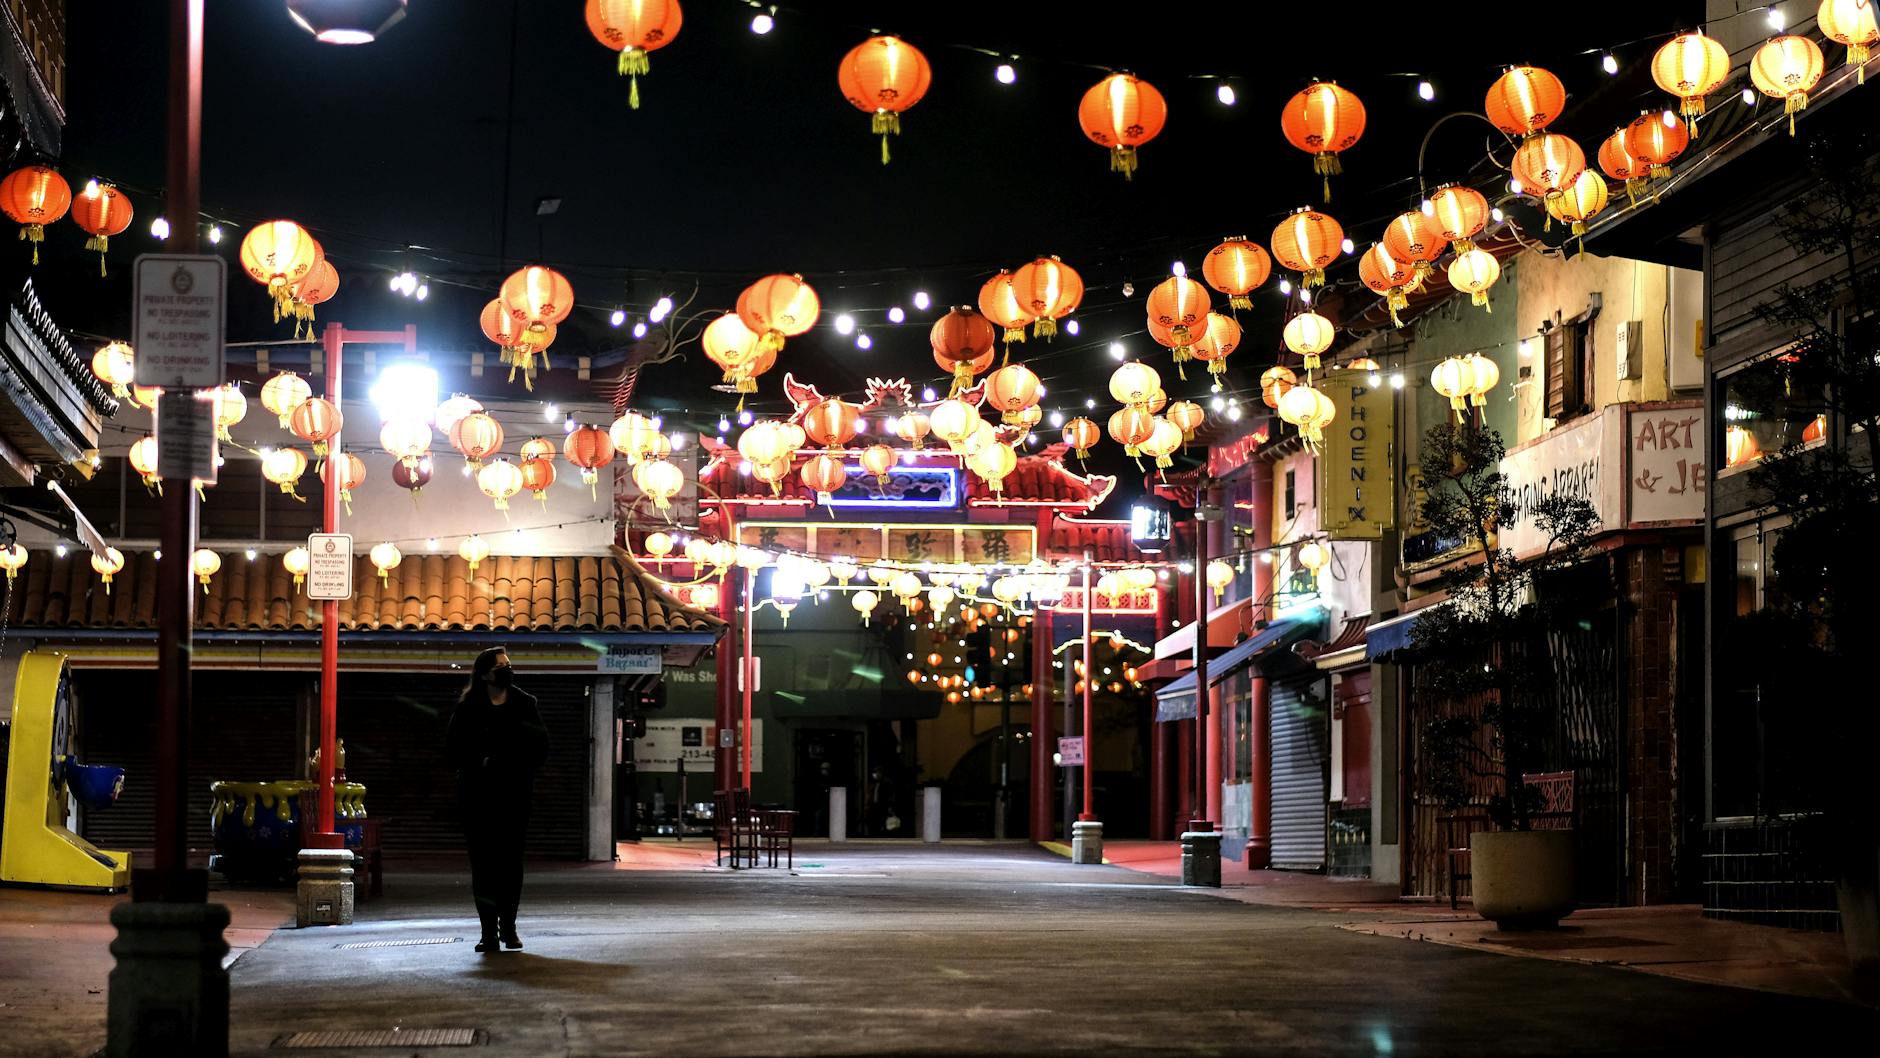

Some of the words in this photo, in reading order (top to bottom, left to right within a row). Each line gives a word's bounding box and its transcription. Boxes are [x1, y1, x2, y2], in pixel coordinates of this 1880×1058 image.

[147, 308, 158, 318] NO
[160, 308, 211, 318] TRESPASSING
[146, 331, 160, 341] NO
[161, 331, 210, 342] LOITERING
[146, 355, 160, 365] NO
[162, 355, 210, 366] DRINKING
[1634, 416, 1701, 451] ART
[1348, 386, 1367, 522] PHOENIX
[1634, 468, 1663, 494] &
[672, 671, 695, 682] Was
